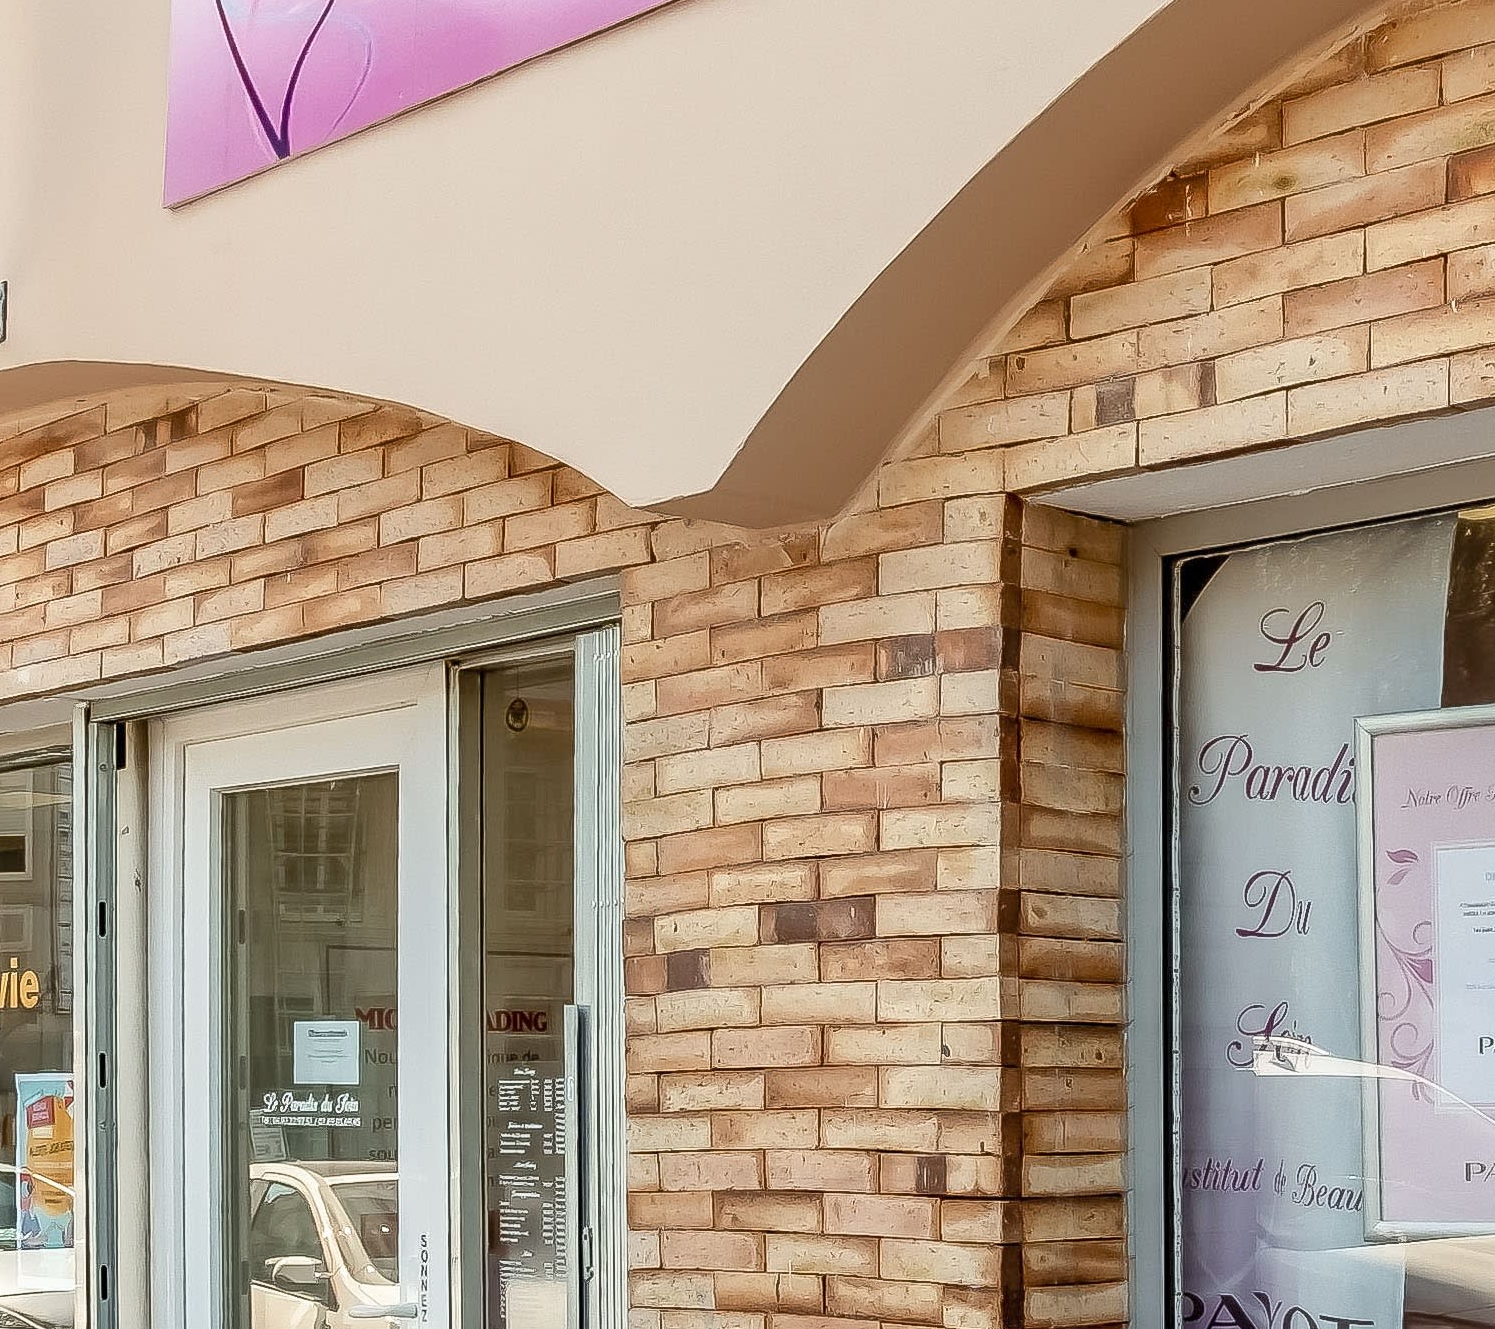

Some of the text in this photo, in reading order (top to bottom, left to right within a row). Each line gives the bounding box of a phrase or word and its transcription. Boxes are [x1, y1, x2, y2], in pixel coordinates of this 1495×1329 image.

[1253, 600, 1333, 673] Le
[1189, 733, 1358, 806] Paradi
[1401, 787, 1441, 808] Notre
[1447, 784, 1480, 809] Offre
[1235, 870, 1311, 939] Du
[1182, 1158, 1263, 1194] stitut
[1292, 1163, 1364, 1212] Beau
